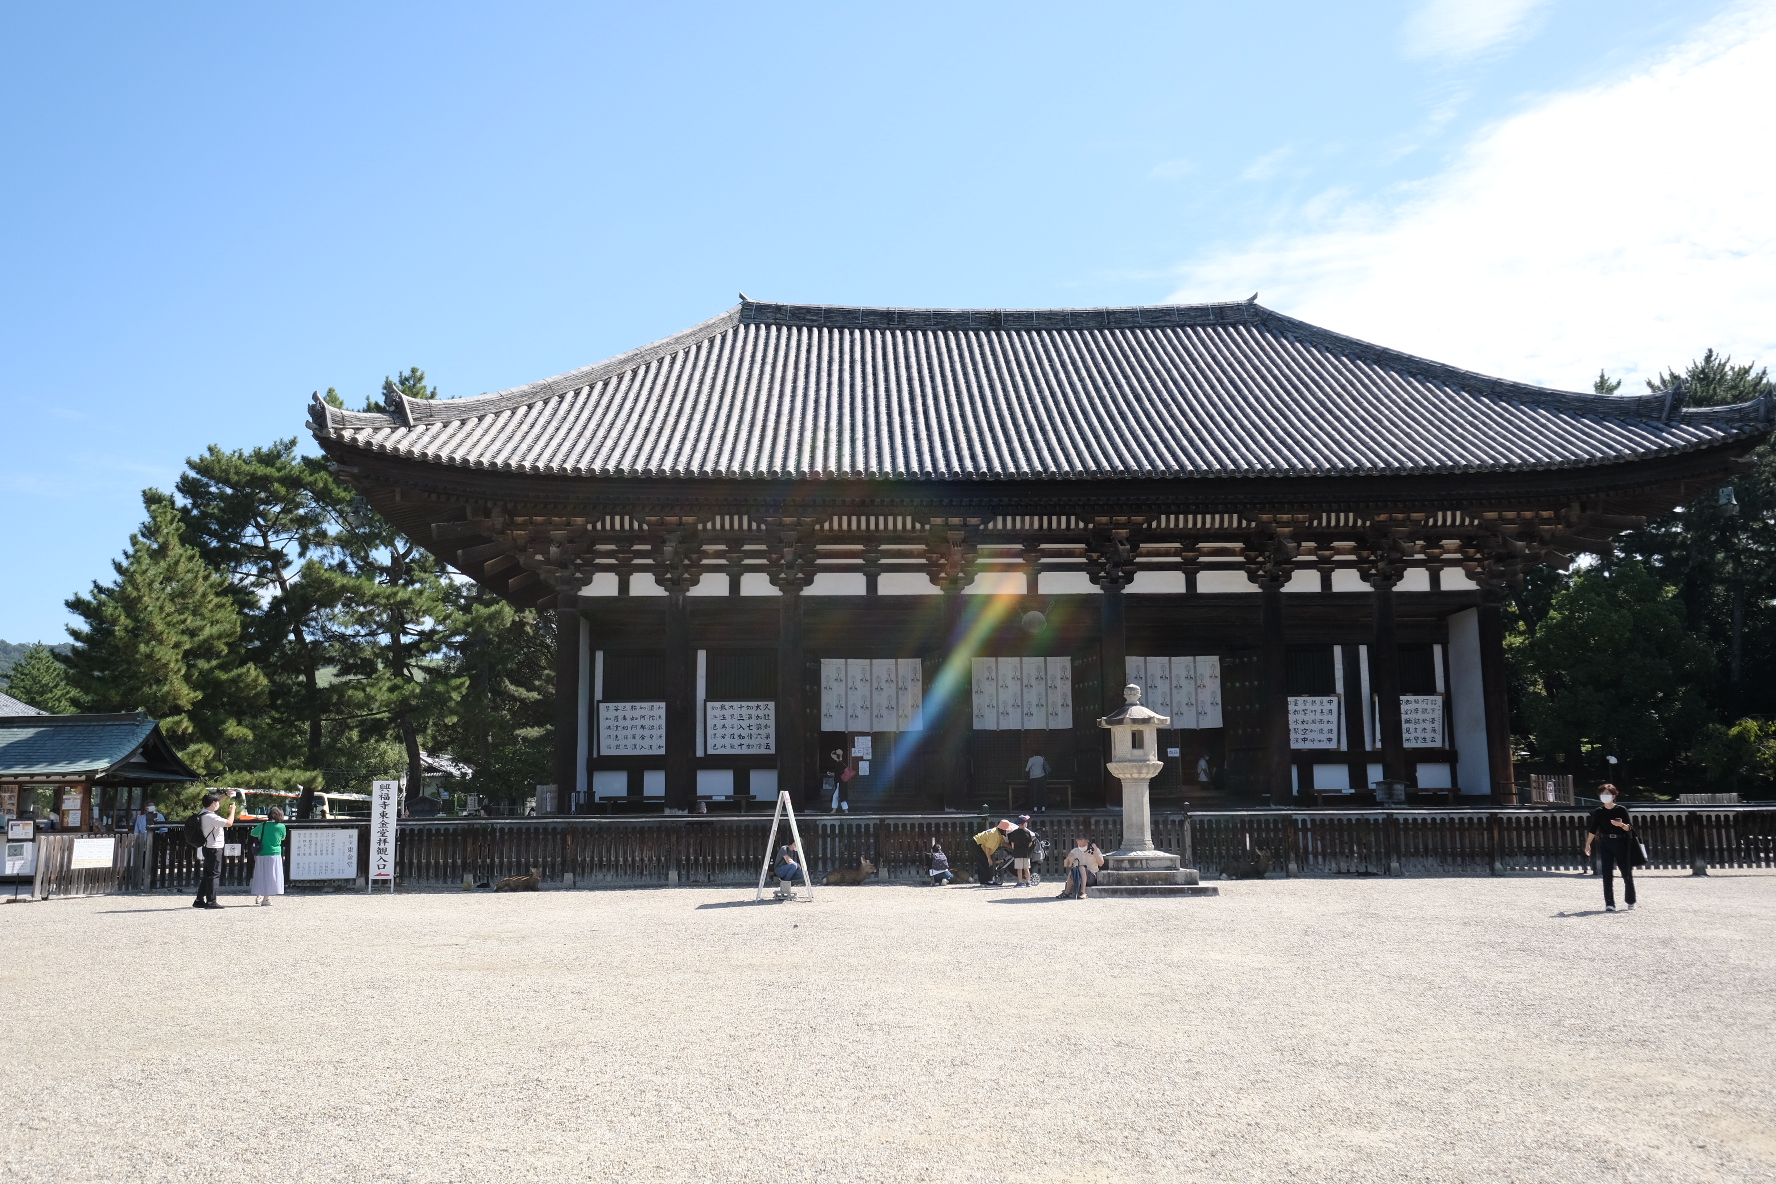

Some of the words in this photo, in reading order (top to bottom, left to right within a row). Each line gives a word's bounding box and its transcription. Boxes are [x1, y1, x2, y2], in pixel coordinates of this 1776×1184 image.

[376, 783, 391, 870] 興福寺東金堂拝観入口
